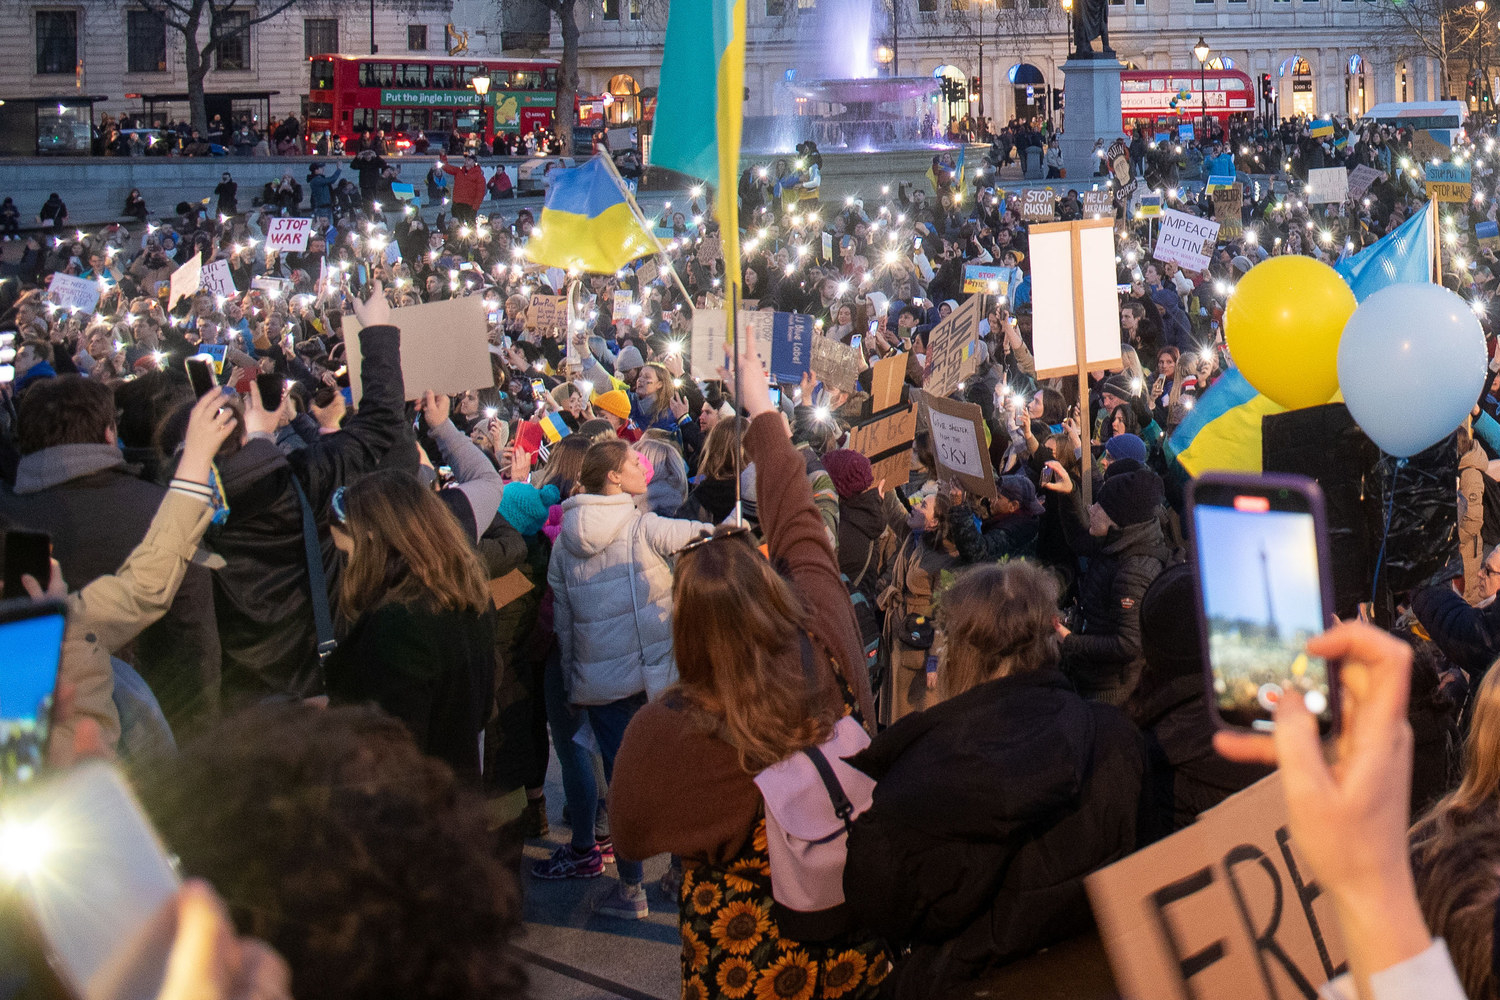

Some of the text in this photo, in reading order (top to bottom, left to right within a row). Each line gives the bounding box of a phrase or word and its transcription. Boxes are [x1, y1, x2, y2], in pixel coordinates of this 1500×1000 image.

[385, 92, 490, 104] Put the jingle in your bll
[1107, 144, 1124, 160] PUTIN
[1026, 190, 1053, 203] STOP
[1116, 179, 1137, 200] GO HOME
[1432, 184, 1468, 200] STOP WAR
[1086, 192, 1108, 204] HELP
[1023, 203, 1053, 215] RUSSIA
[1084, 204, 1113, 214] UKRAINE
[274, 219, 308, 231] STOP
[1163, 214, 1218, 240] IMPEACH
[271, 233, 302, 244] WAR
[1163, 233, 1202, 254] PUTIN
[794, 324, 805, 340] Blue
[949, 302, 974, 354] UN
[792, 342, 803, 365] Label
[941, 443, 966, 465] SKY
